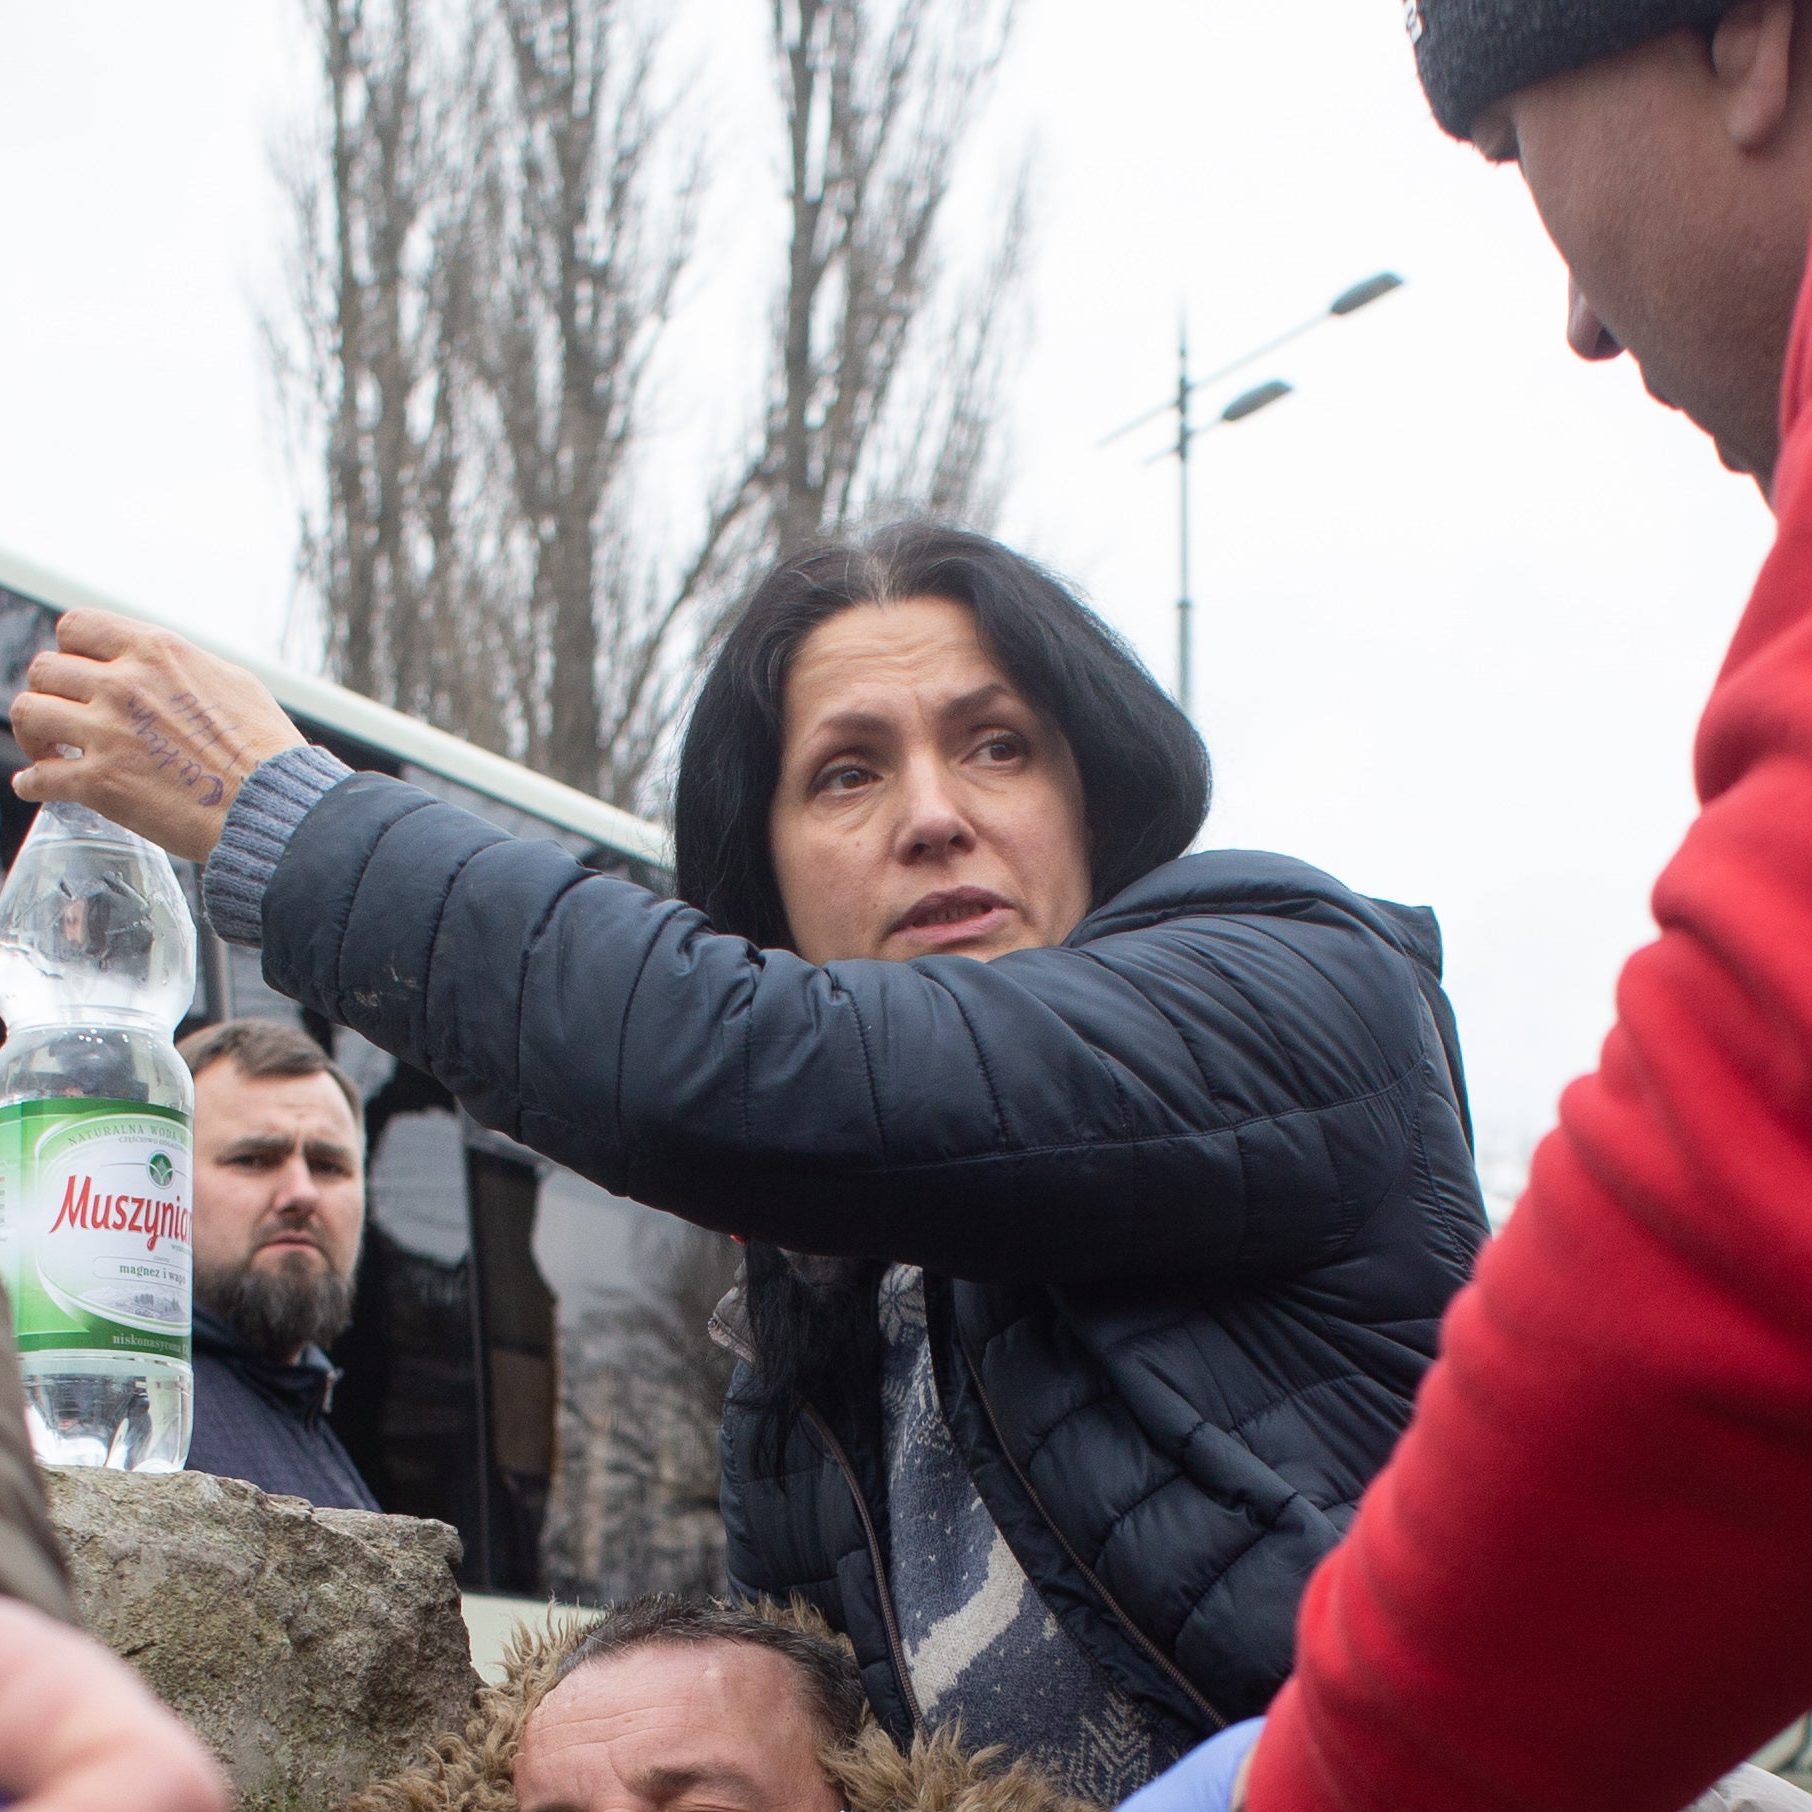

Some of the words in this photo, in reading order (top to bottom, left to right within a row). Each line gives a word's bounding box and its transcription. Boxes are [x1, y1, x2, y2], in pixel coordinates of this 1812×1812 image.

[68, 1124, 144, 1146] NATURALNA
[150, 1124, 178, 1141] WODA
[119, 1264, 160, 1277] magnez
[163, 1267, 167, 1279] i
